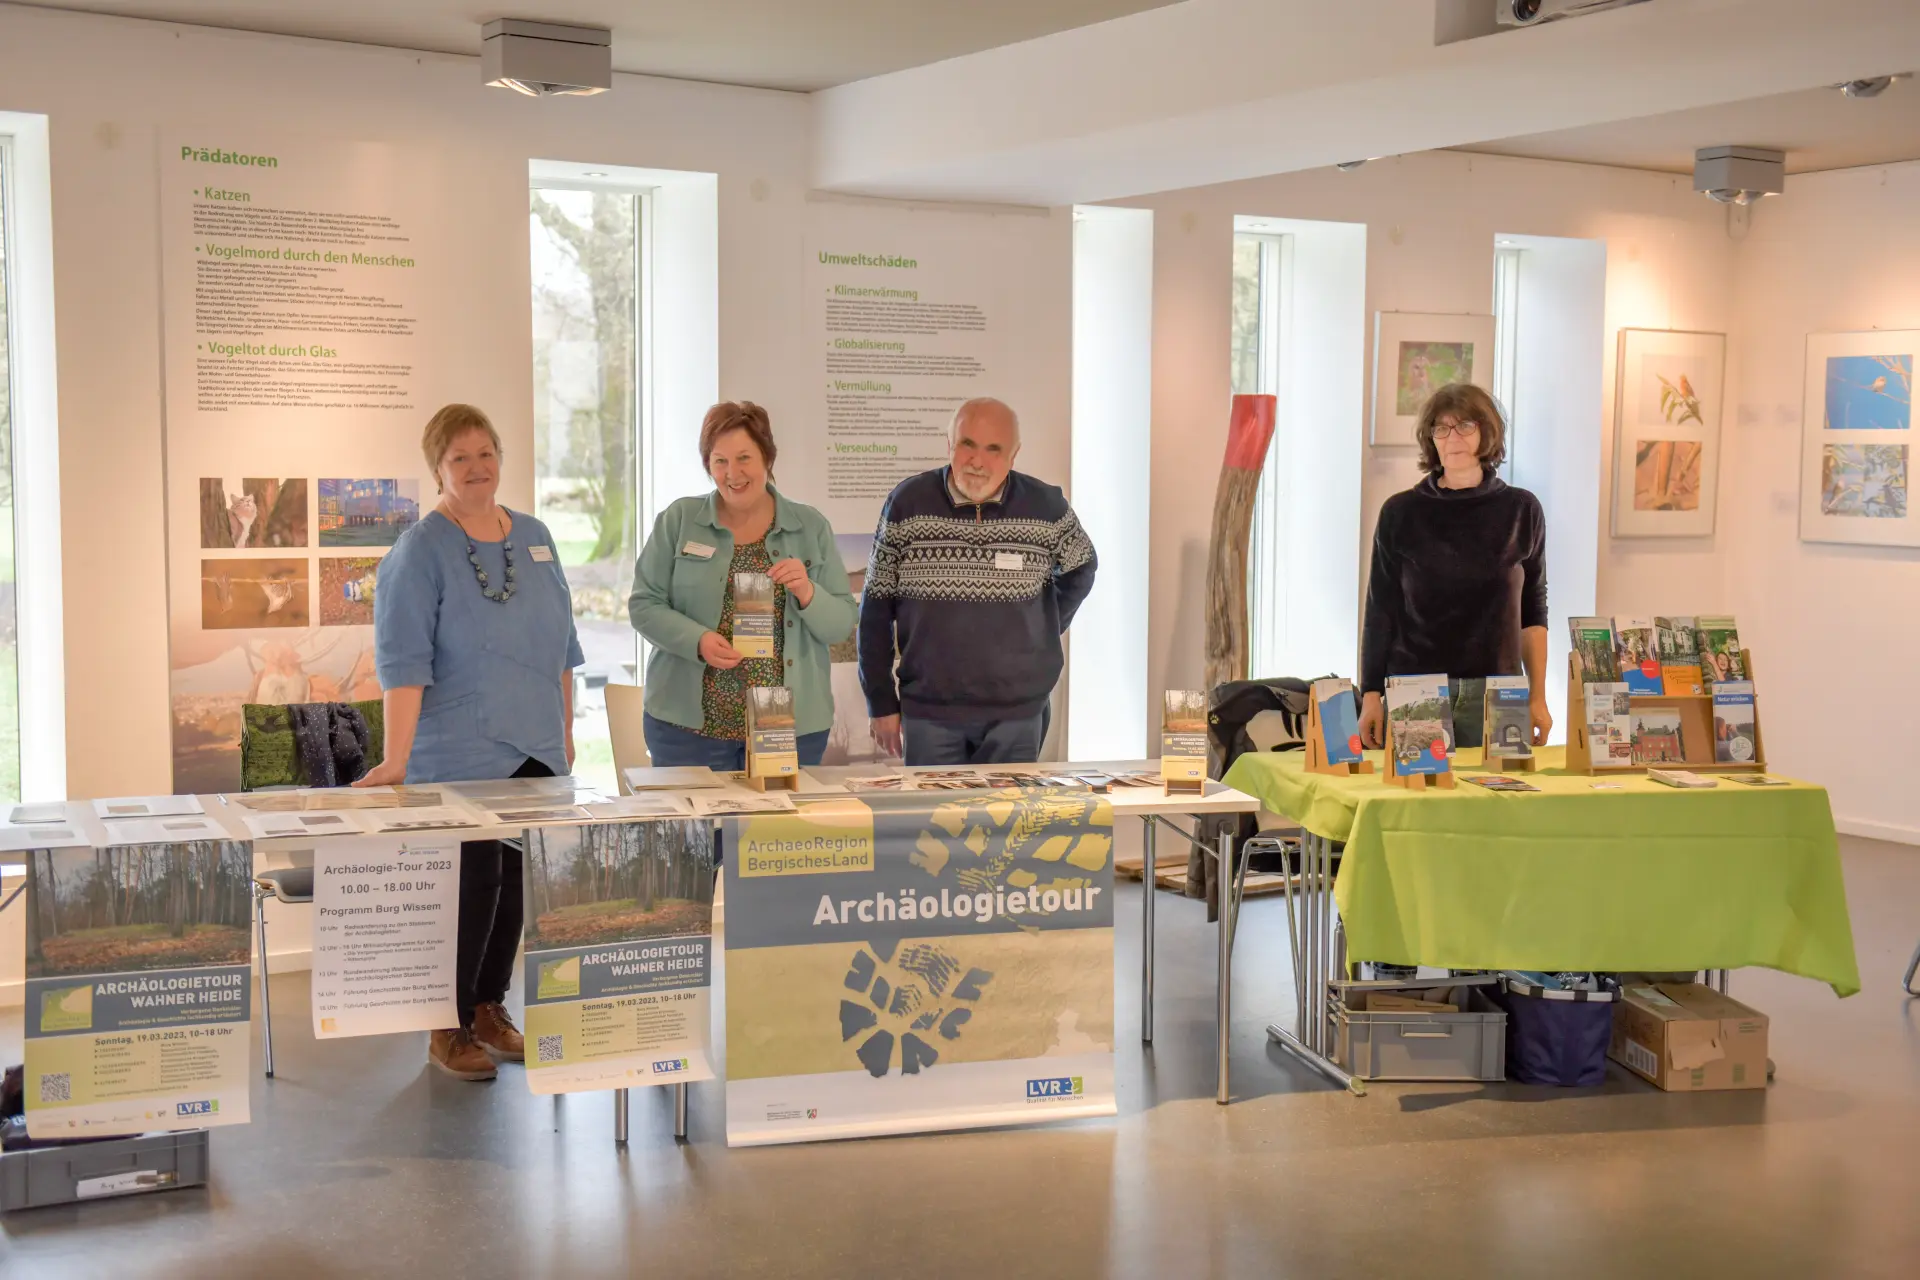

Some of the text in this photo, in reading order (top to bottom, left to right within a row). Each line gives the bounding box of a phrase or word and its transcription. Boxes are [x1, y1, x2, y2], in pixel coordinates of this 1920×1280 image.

[181, 146, 278, 168] Prädatoren
[204, 187, 250, 202] Katzen
[206, 243, 414, 268] Vogelmord durch den Menschen
[818, 251, 918, 268] Umweltschäden
[834, 285, 918, 301] Klimaerwärmung
[208, 342, 337, 358] Vogeltot durch Glas
[834, 338, 906, 352] Globalisierung
[834, 380, 892, 394] Vermüllung
[834, 442, 898, 456] Verseuchung
[748, 836, 868, 853] ArchaeoRegion
[324, 860, 452, 875] Archäologie-Tour 2023
[748, 852, 868, 872] BergischesLand
[340, 884, 370, 894] 10.00
[384, 882, 412, 892] 18.00
[416, 881, 436, 891] Uhr
[320, 903, 442, 918] Programm Burg Wissem
[812, 886, 1102, 926] Archäologietour
[582, 944, 704, 966] ARCHÄOLOGIETOUR
[611, 958, 704, 976] WAHNER HEIDE
[96, 974, 242, 996] ARCHÄOLOGIETOUR
[131, 989, 242, 1008] WAHNER HEIDE
[582, 1003, 614, 1011] Sonntag,
[616, 997, 658, 1007] 19.03.2023,
[95, 1036, 134, 1046] Sonntag,
[137, 1032, 187, 1042] 19.03.2023,
[217, 1028, 233, 1036] Uhr
[654, 1062, 675, 1072] LVR
[1029, 1080, 1061, 1096] LVR
[178, 1102, 202, 1114] LVR
